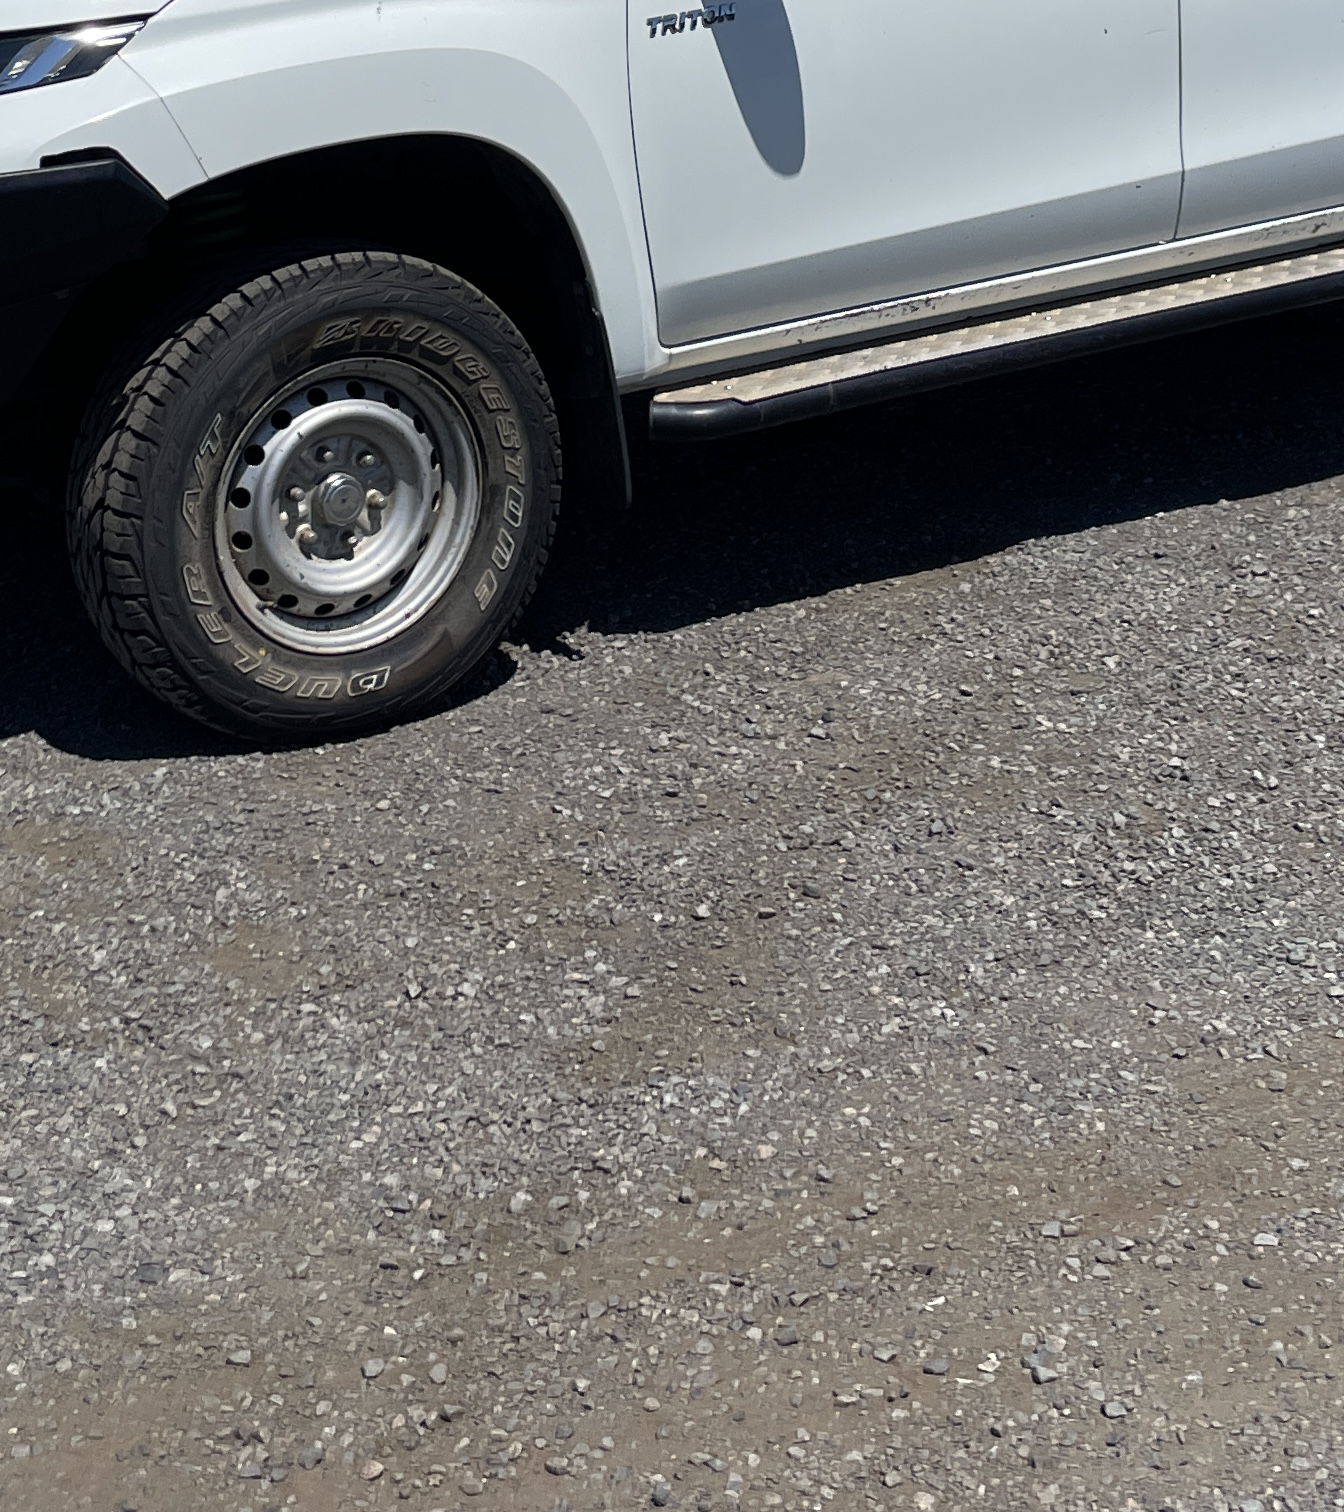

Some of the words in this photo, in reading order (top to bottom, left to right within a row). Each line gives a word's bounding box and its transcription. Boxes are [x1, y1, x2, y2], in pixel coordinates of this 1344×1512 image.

[645, 1, 737, 39] TRITON
[312, 315, 526, 612] BRIDGESTONE
[182, 563, 392, 700] DUELER
